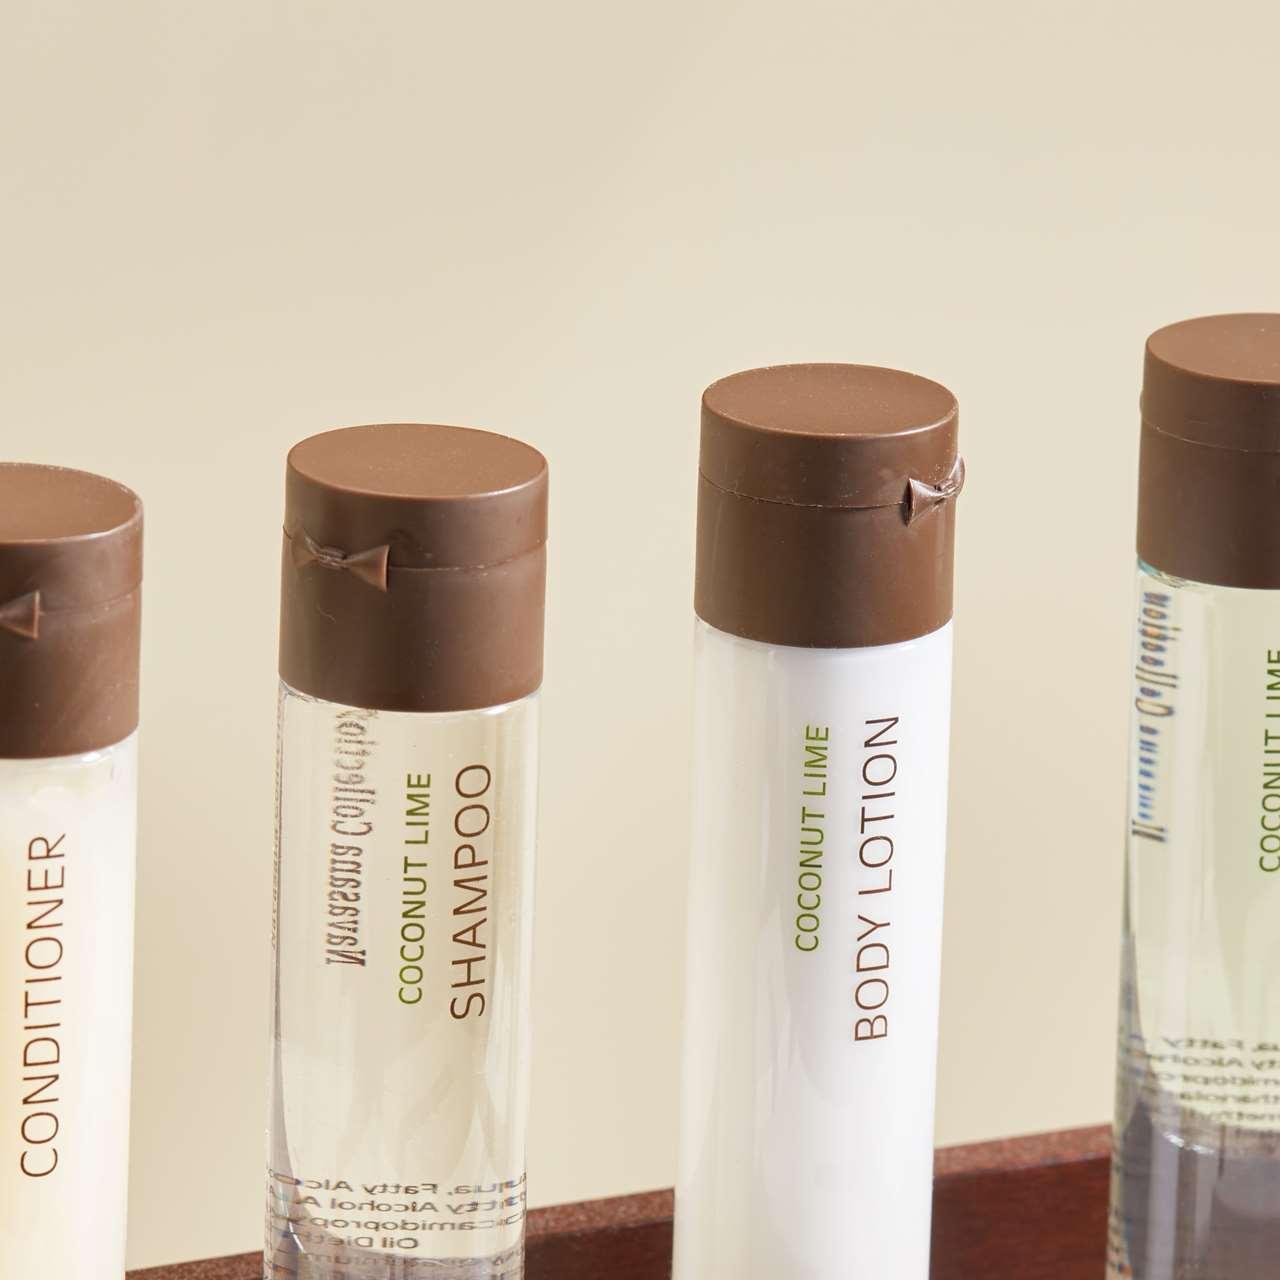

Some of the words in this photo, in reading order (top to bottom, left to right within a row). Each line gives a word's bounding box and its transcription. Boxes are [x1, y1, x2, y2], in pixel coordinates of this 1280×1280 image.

[404, 773, 432, 846] LIME
[802, 724, 830, 797] LIME
[858, 716, 900, 896] LOTION
[398, 856, 428, 1006] COCONUT
[450, 764, 492, 1020] SHAMPOO
[794, 805, 825, 953] COCONUT
[20, 833, 67, 1179] CONDITIONER
[853, 914, 892, 1043] BODY
